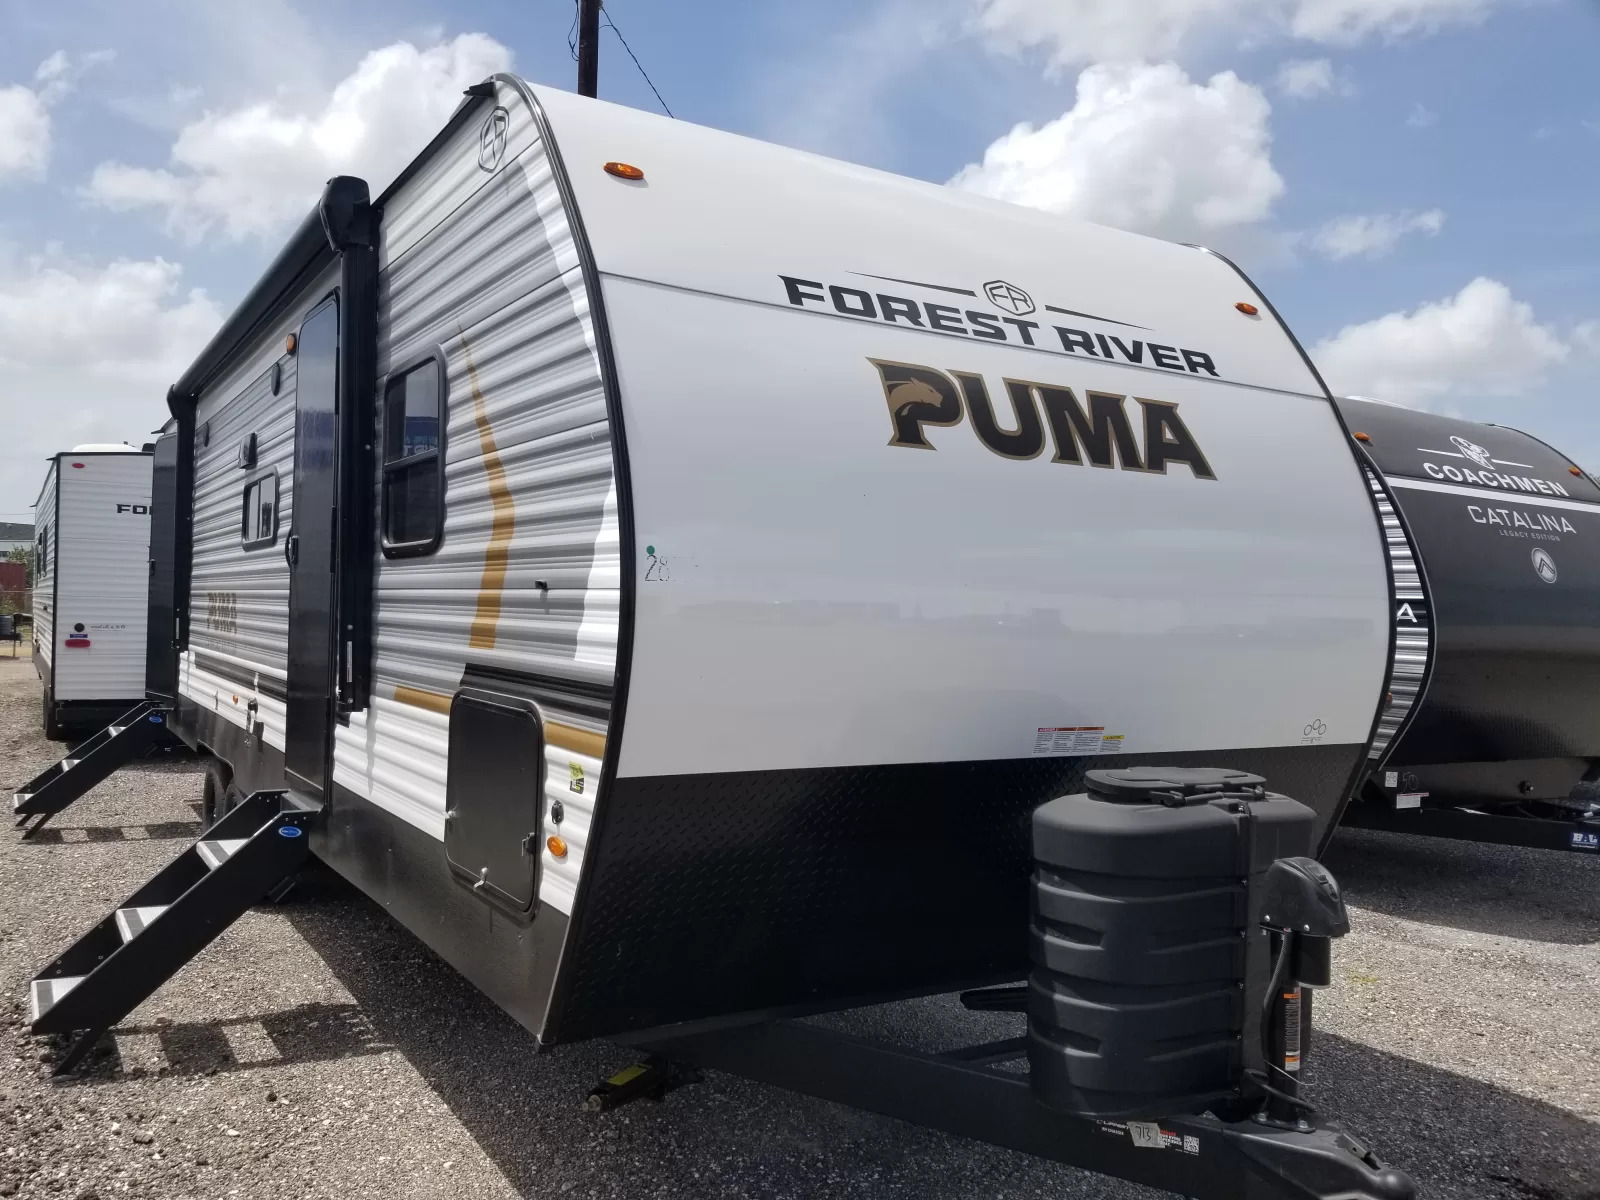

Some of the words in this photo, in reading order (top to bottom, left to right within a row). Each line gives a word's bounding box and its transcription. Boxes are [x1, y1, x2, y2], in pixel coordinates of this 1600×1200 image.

[777, 275, 1040, 346] FOREST
[1052, 325, 1221, 378] RIVER
[864, 356, 1218, 482] PUMA
[1422, 462, 1570, 497] COACHMEN
[116, 503, 152, 515] FO
[1467, 505, 1577, 535] CATALINA
[1498, 529, 1529, 539] LEGACY
[1530, 533, 1561, 542] EDITION
